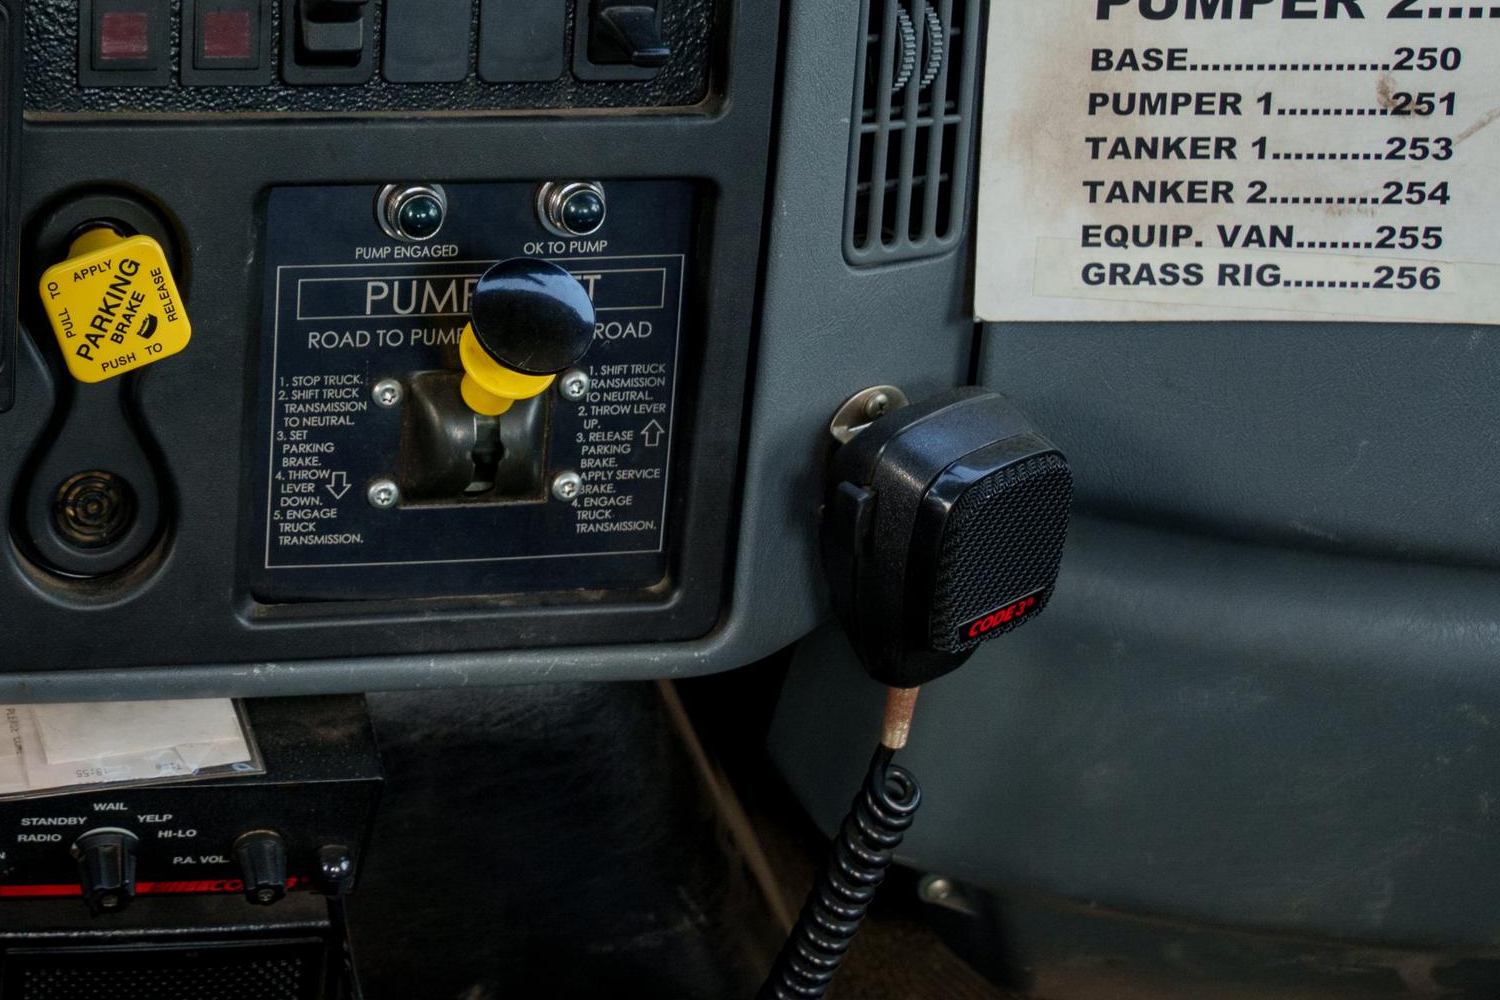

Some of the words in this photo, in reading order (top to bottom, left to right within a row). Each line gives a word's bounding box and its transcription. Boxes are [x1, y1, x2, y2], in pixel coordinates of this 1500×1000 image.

[1087, 91, 1243, 116] PUMPER
[1084, 136, 1237, 161] TANKER
[1082, 180, 1235, 204] TANKER
[1081, 224, 1203, 251] EQUIP.
[355, 247, 391, 260] PUMP
[394, 244, 459, 258] ENGAGED
[523, 242, 545, 255] OK
[547, 241, 566, 254] TO
[569, 240, 608, 253] PUMP
[73, 259, 112, 282] APPLY
[1081, 262, 1204, 287] GRASS
[47, 281, 61, 300] TO
[150, 267, 179, 323] RELEASE
[75, 258, 141, 362] PARKING
[58, 307, 77, 339] PULL
[110, 290, 146, 344] BRAKE
[592, 321, 653, 340] ROAD
[308, 330, 371, 349] ROAD
[376, 329, 404, 347] TO
[101, 352, 137, 372] PUSH
[144, 342, 163, 356] TO
[589, 365, 598, 376] 1.
[600, 364, 629, 375] SHIFT
[630, 363, 666, 374] TRUCK
[279, 376, 289, 387] 1.
[291, 375, 321, 387] STOP
[323, 374, 364, 385] TRUCK.
[278, 390, 289, 401] 2.
[291, 389, 320, 400] SHIFT
[322, 388, 359, 399] TRUCK
[603, 390, 654, 402] NEUTRAL.
[284, 401, 368, 414] TRANSMISSION
[577, 406, 588, 417] 2.
[590, 404, 632, 415] THROW
[633, 403, 667, 414] LEVER
[284, 416, 300, 428] TO
[302, 415, 355, 427] NEUTRAL.
[583, 419, 601, 430] UP.
[276, 430, 287, 441] 3.
[289, 430, 308, 440] SET
[575, 432, 586, 443] 3.
[588, 430, 634, 442] RELEASE
[282, 442, 335, 454] PARKING
[581, 444, 632, 456] PARKING
[282, 456, 322, 467] BRAKE.
[580, 457, 618, 469] BRAKE.
[275, 471, 285, 481] 4.
[288, 469, 331, 480] THROW
[580, 470, 614, 481] APPLY
[615, 468, 661, 480] SERVICE
[281, 483, 315, 494] LEVER
[280, 496, 323, 507] DOWN.
[583, 495, 633, 508] ENGAGE
[273, 510, 284, 520] 5.
[286, 508, 338, 520] ENGAGE
[576, 509, 612, 521] TRUCK
[279, 521, 317, 533] TRUCK
[575, 520, 657, 534] TRANSMISSION.
[278, 533, 364, 546] TRANSMISSION.
[968, 604, 1017, 638] CODE
[93, 802, 128, 811] WAIL
[21, 816, 88, 826] STANDBY
[137, 814, 173, 823] YELP
[17, 833, 62, 843] RADIO
[157, 829, 197, 839] HI-LO
[200, 855, 230, 864] VOL.
